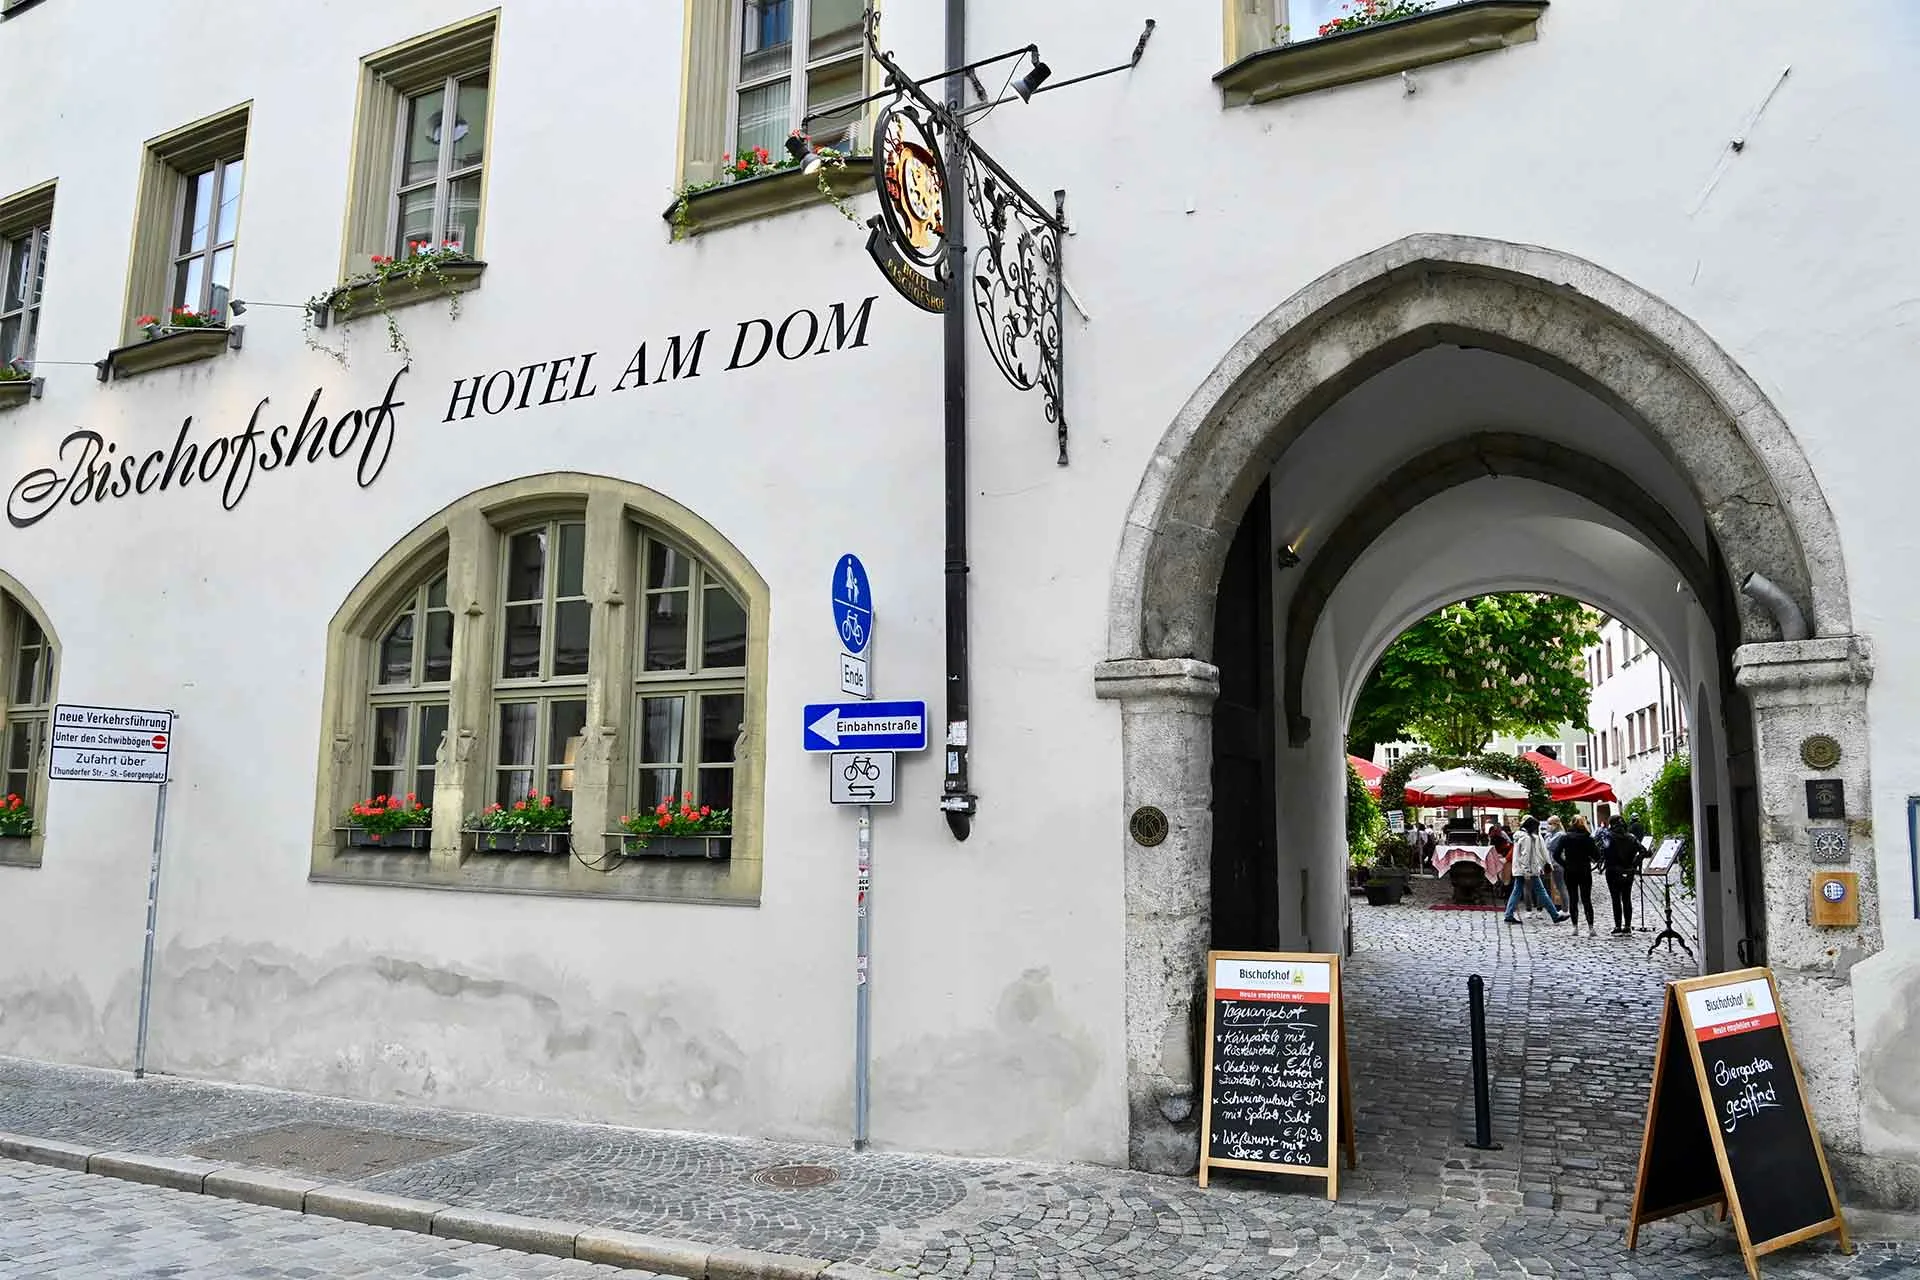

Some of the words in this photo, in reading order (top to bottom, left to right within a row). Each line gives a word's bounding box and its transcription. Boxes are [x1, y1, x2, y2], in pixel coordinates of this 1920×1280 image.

[903, 262, 929, 292] HOTEL
[442, 352, 597, 423] HOTEL
[612, 328, 711, 392] AM
[723, 295, 879, 372] DOM
[7, 365, 410, 528] Bischofshof
[844, 664, 864, 688] Ende
[59, 711, 84, 723] neue
[86, 711, 167, 730] Verkehrsführung
[836, 719, 919, 734] Einbahnstraße
[55, 731, 79, 742] Unter
[80, 733, 96, 743] den
[98, 734, 151, 748] Schwibbögen
[75, 752, 118, 765] Zufahrt
[119, 755, 147, 767] über
[53, 766, 90, 776] Thundorfer
[1239, 968, 1290, 981] Bischofshof
[1704, 992, 1744, 1012] Bischofshof
[1284, 1030, 1306, 1042] mit
[1714, 1057, 1774, 1086] Biergarten
[1222, 1108, 1242, 1120] mit
[1725, 1082, 1777, 1133] geöffnet
[1280, 1138, 1307, 1151] mit
